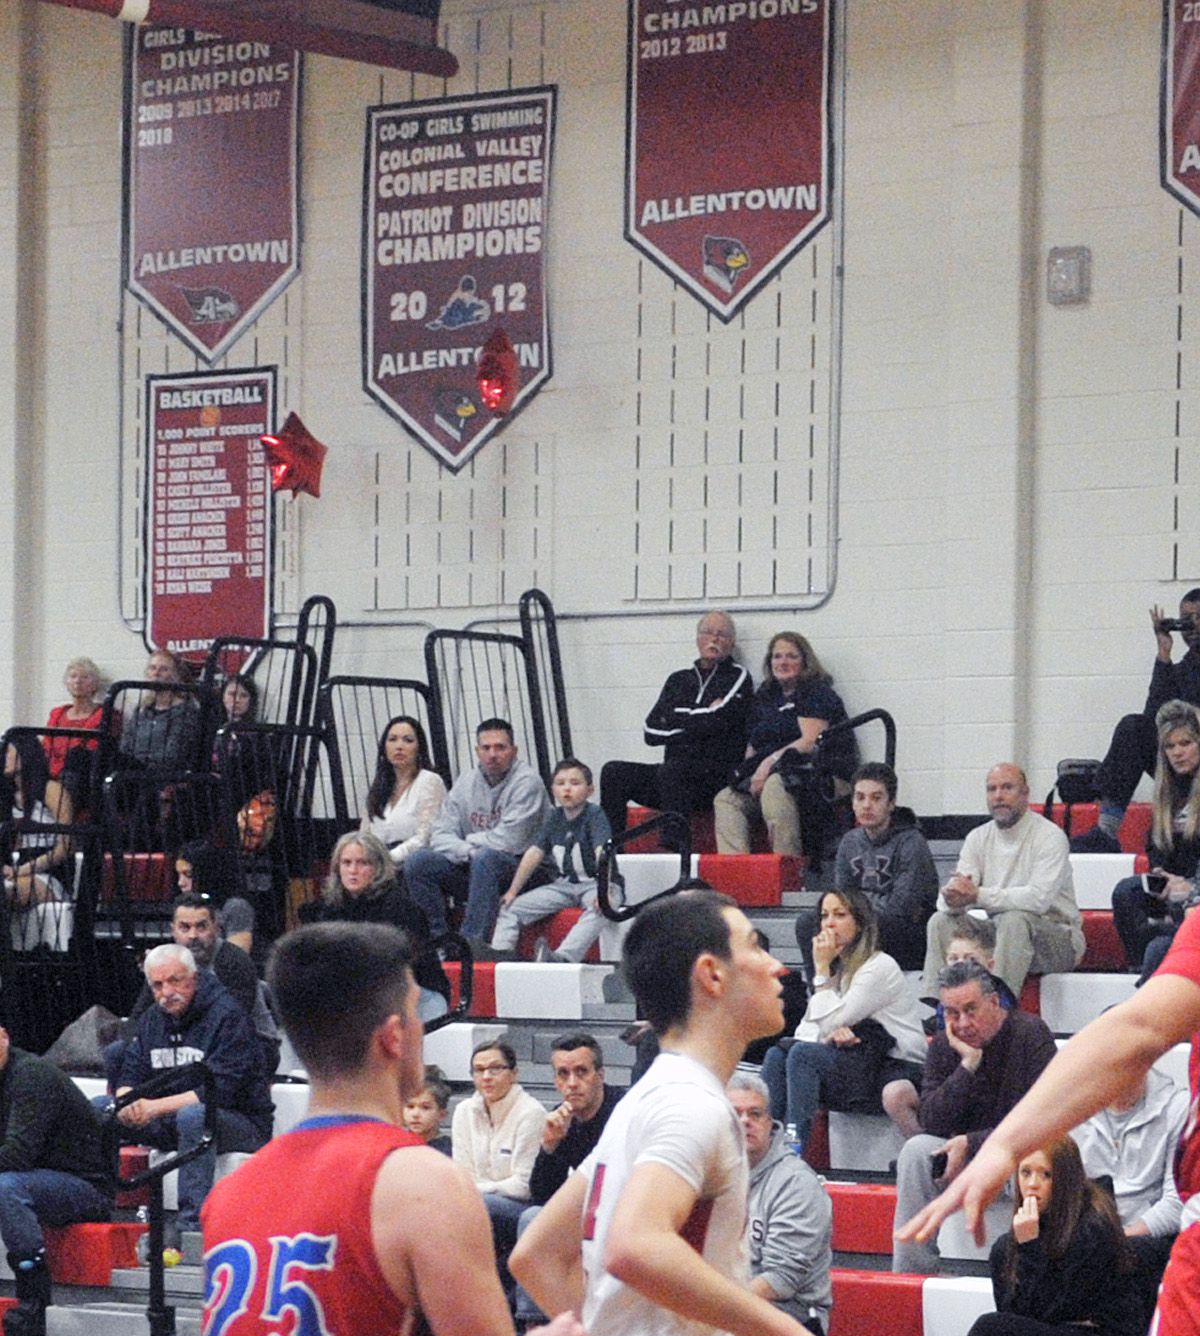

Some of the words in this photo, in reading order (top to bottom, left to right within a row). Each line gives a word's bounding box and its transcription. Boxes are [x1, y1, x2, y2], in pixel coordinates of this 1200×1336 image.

[643, 0, 819, 32] CHAMPIONS
[144, 28, 186, 48] GIRLS
[160, 41, 271, 71] DIVISION
[640, 37, 681, 59] 2012
[686, 31, 727, 54] 2013
[141, 62, 290, 98] CHAMPIONS
[379, 121, 419, 141] CO-OP
[426, 115, 464, 136] GIRLS
[471, 107, 543, 132] SWIMMING
[378, 144, 466, 173] COLONIAL
[475, 135, 543, 157] VALLEY
[378, 159, 544, 198] CONFERENCE
[377, 205, 453, 238] PATRIOT
[462, 198, 542, 229] DIVISION
[640, 184, 818, 227] ALLENTOWN
[139, 239, 288, 277] ALLENTOWN
[377, 226, 542, 266] CHAMPIONS
[390, 290, 428, 321] 20
[491, 282, 527, 313] 12
[377, 342, 540, 380] ALLENTN
[159, 386, 263, 410] BASKETBALL
